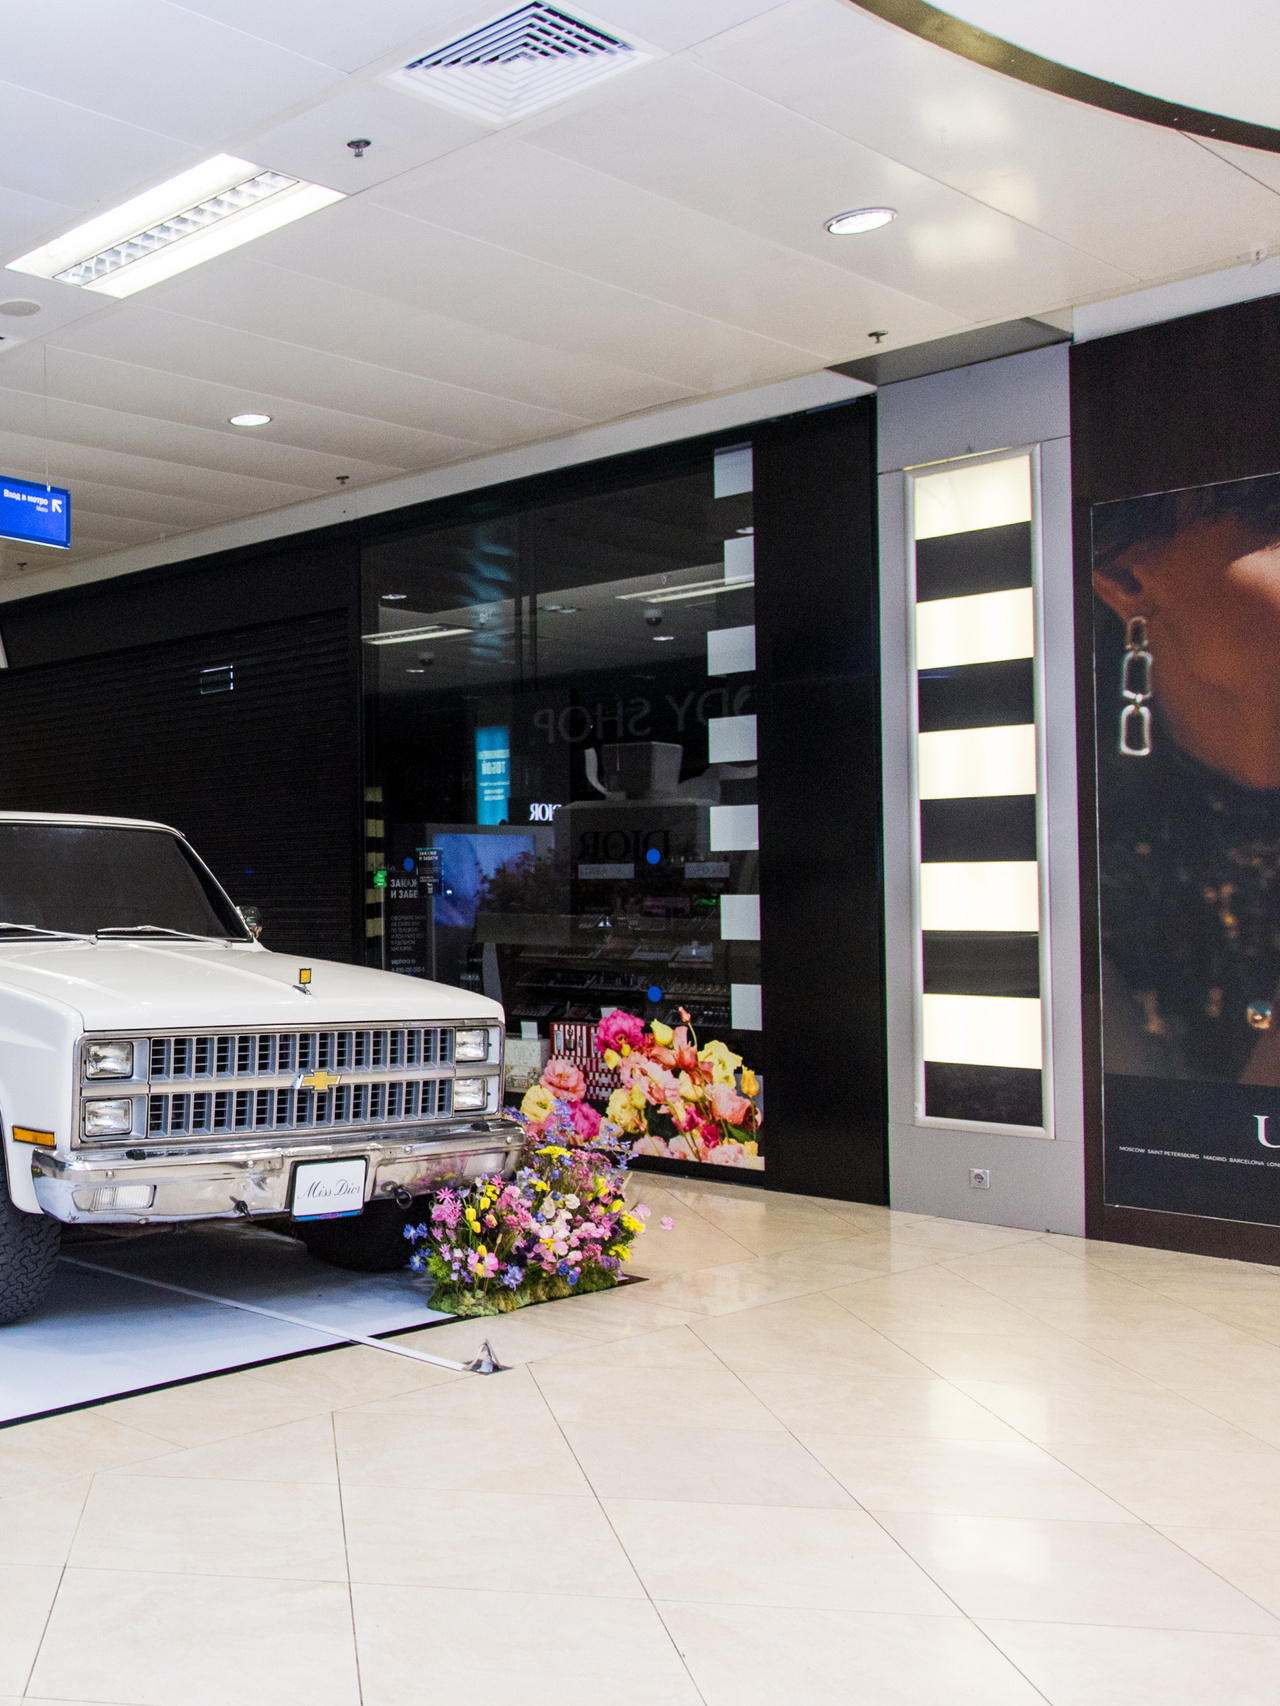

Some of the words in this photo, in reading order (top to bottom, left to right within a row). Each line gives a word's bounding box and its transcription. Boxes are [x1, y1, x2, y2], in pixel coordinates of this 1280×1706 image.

[3, 488, 20, 501] Вход
[27, 495, 48, 506] метро
[390, 879, 418, 888] ЗАКАЖ
[390, 889, 397, 899] И
[398, 889, 418, 899] ЗАБЕ
[1119, 1146, 1145, 1154] MOSCOW
[1164, 1150, 1200, 1159] PETERSBURG
[1203, 1154, 1227, 1162] MADRID
[1229, 1157, 1265, 1166] BARCELONA
[296, 1180, 332, 1200] Miss
[334, 1178, 361, 1197] Dior
